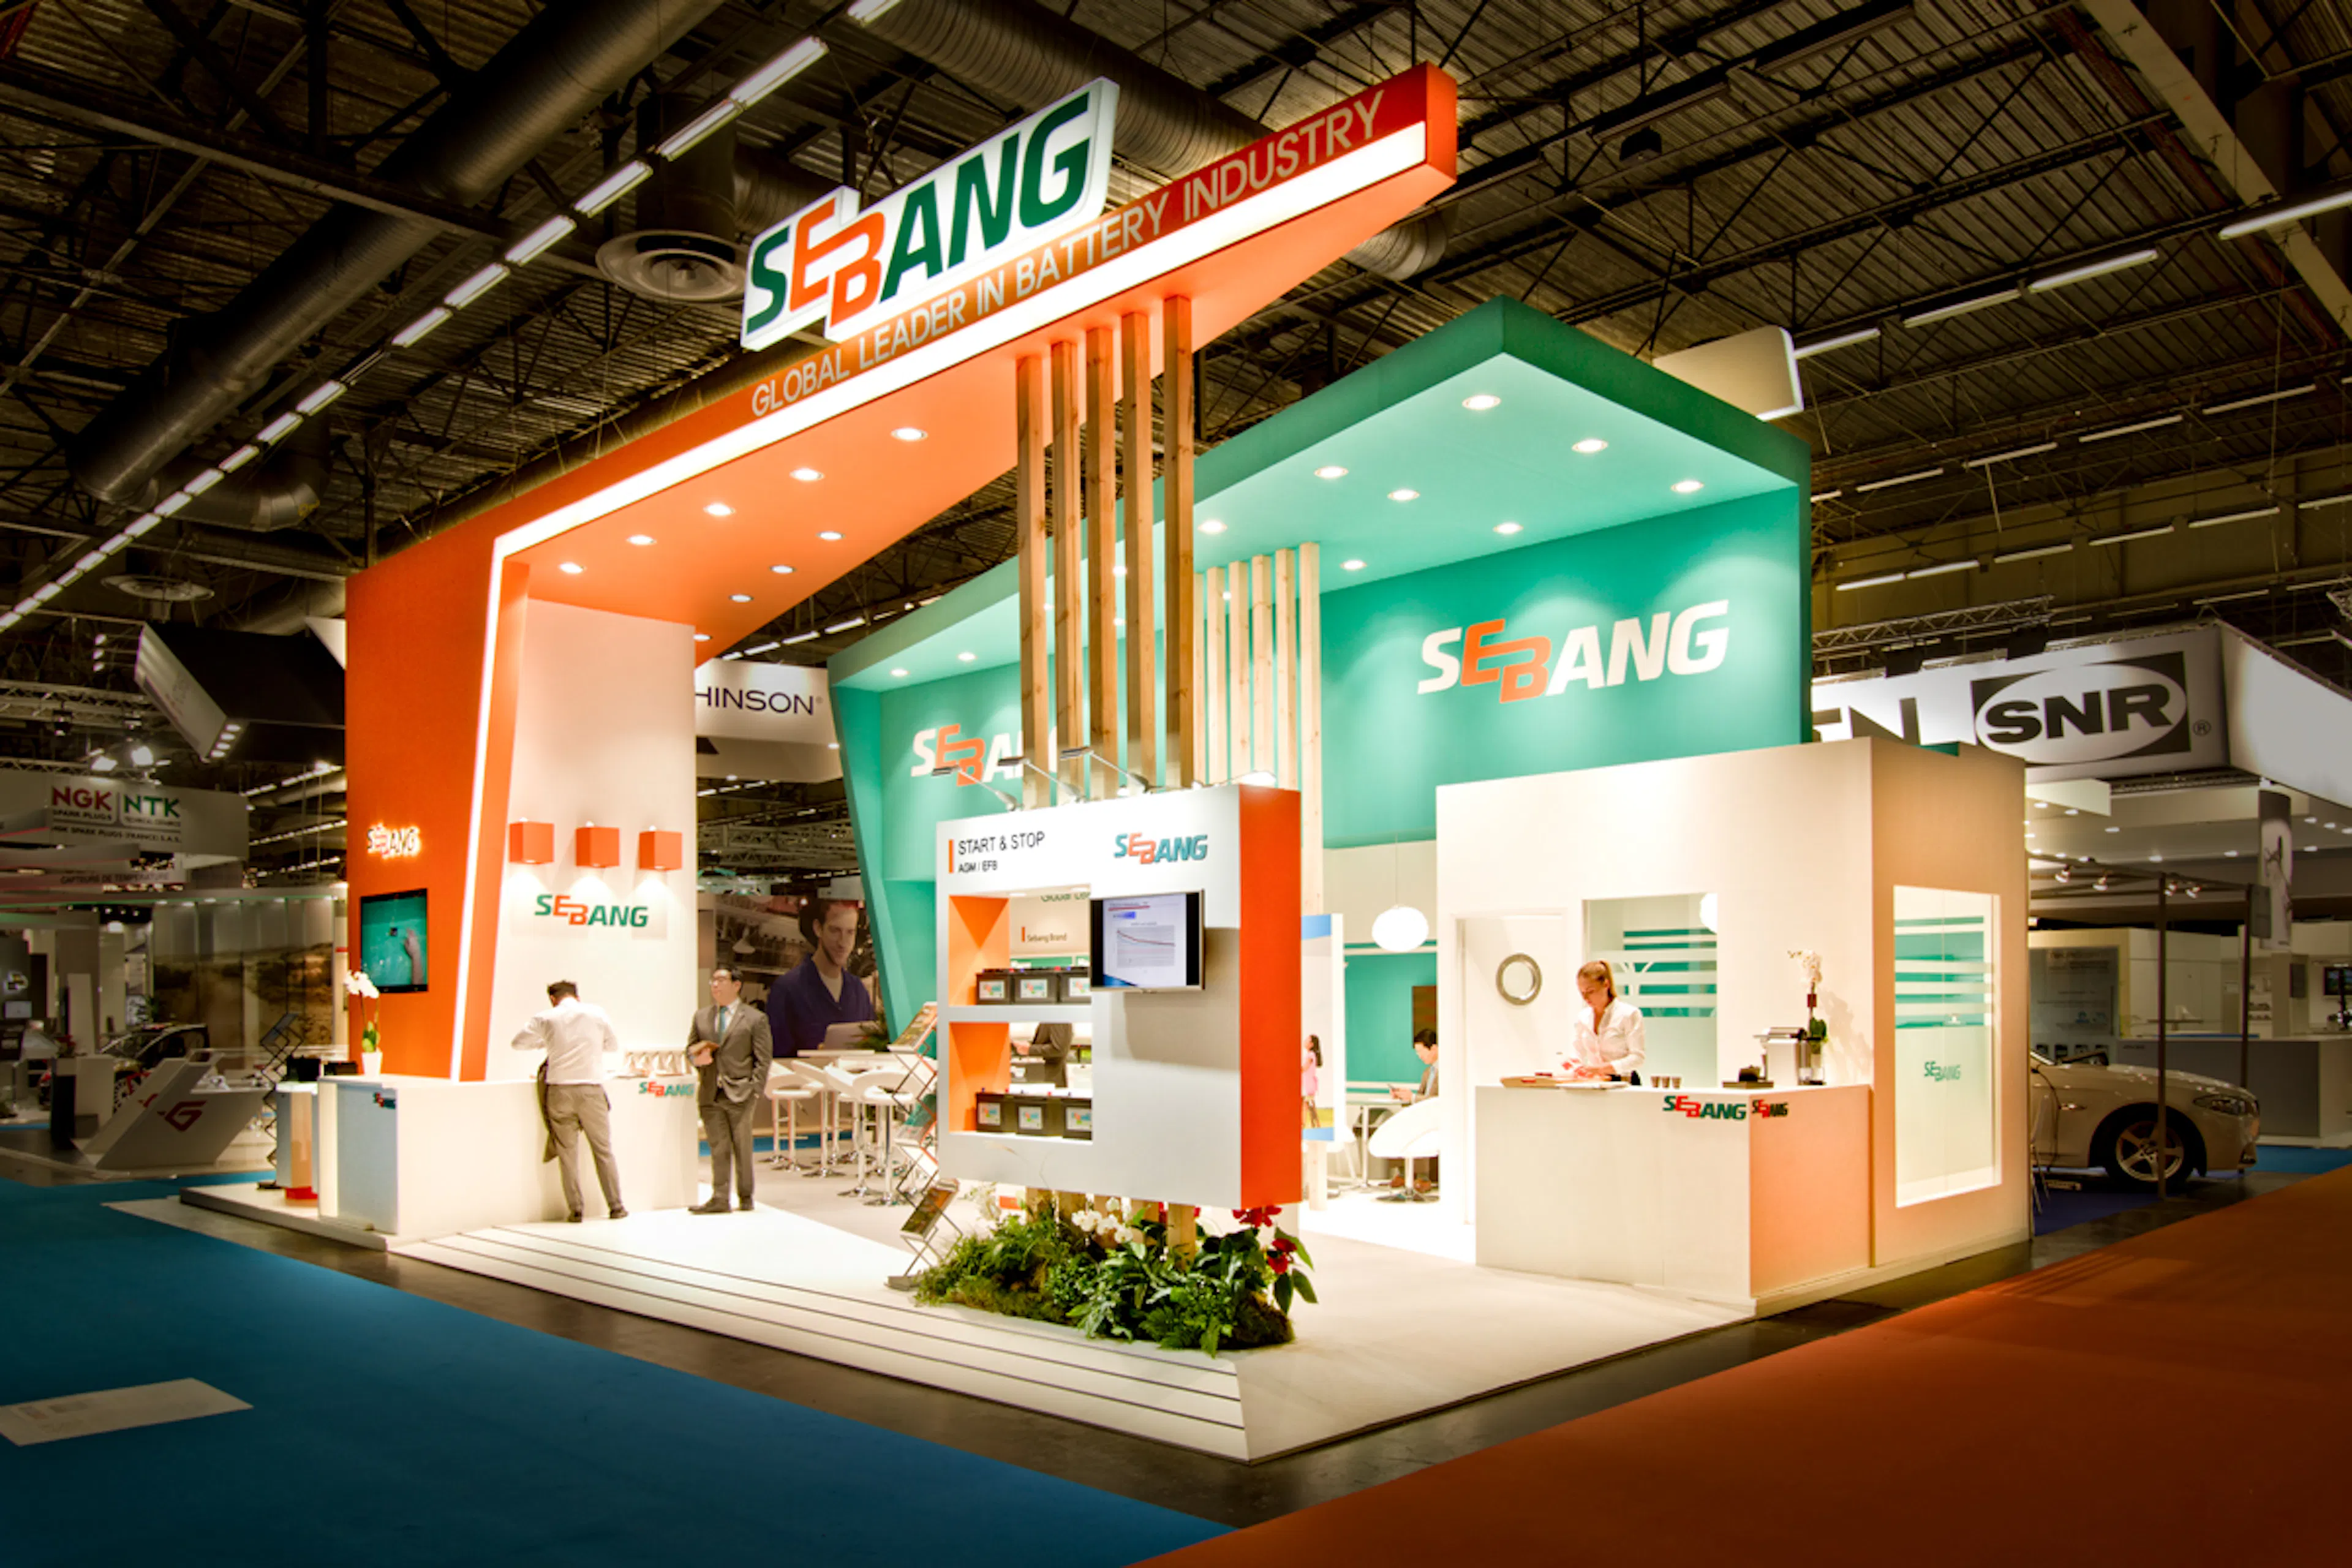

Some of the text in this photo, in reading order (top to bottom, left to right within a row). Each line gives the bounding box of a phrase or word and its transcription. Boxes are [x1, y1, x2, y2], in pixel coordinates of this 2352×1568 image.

[746, 89, 1091, 337] SEBANG
[752, 89, 1385, 417] GLOBAL LEADER IN BATTERY INDUSTRY
[1417, 599, 1729, 703] SEBANG
[1985, 683, 2173, 744] SNR
[51, 786, 180, 818] NGK NTK
[958, 831, 1046, 855] START & STOP
[1114, 832, 1208, 865] SEBANG
[534, 894, 649, 927] SEBANG
[639, 1082, 695, 1097] SEBANG
[1662, 1095, 1747, 1120] SEBANG
